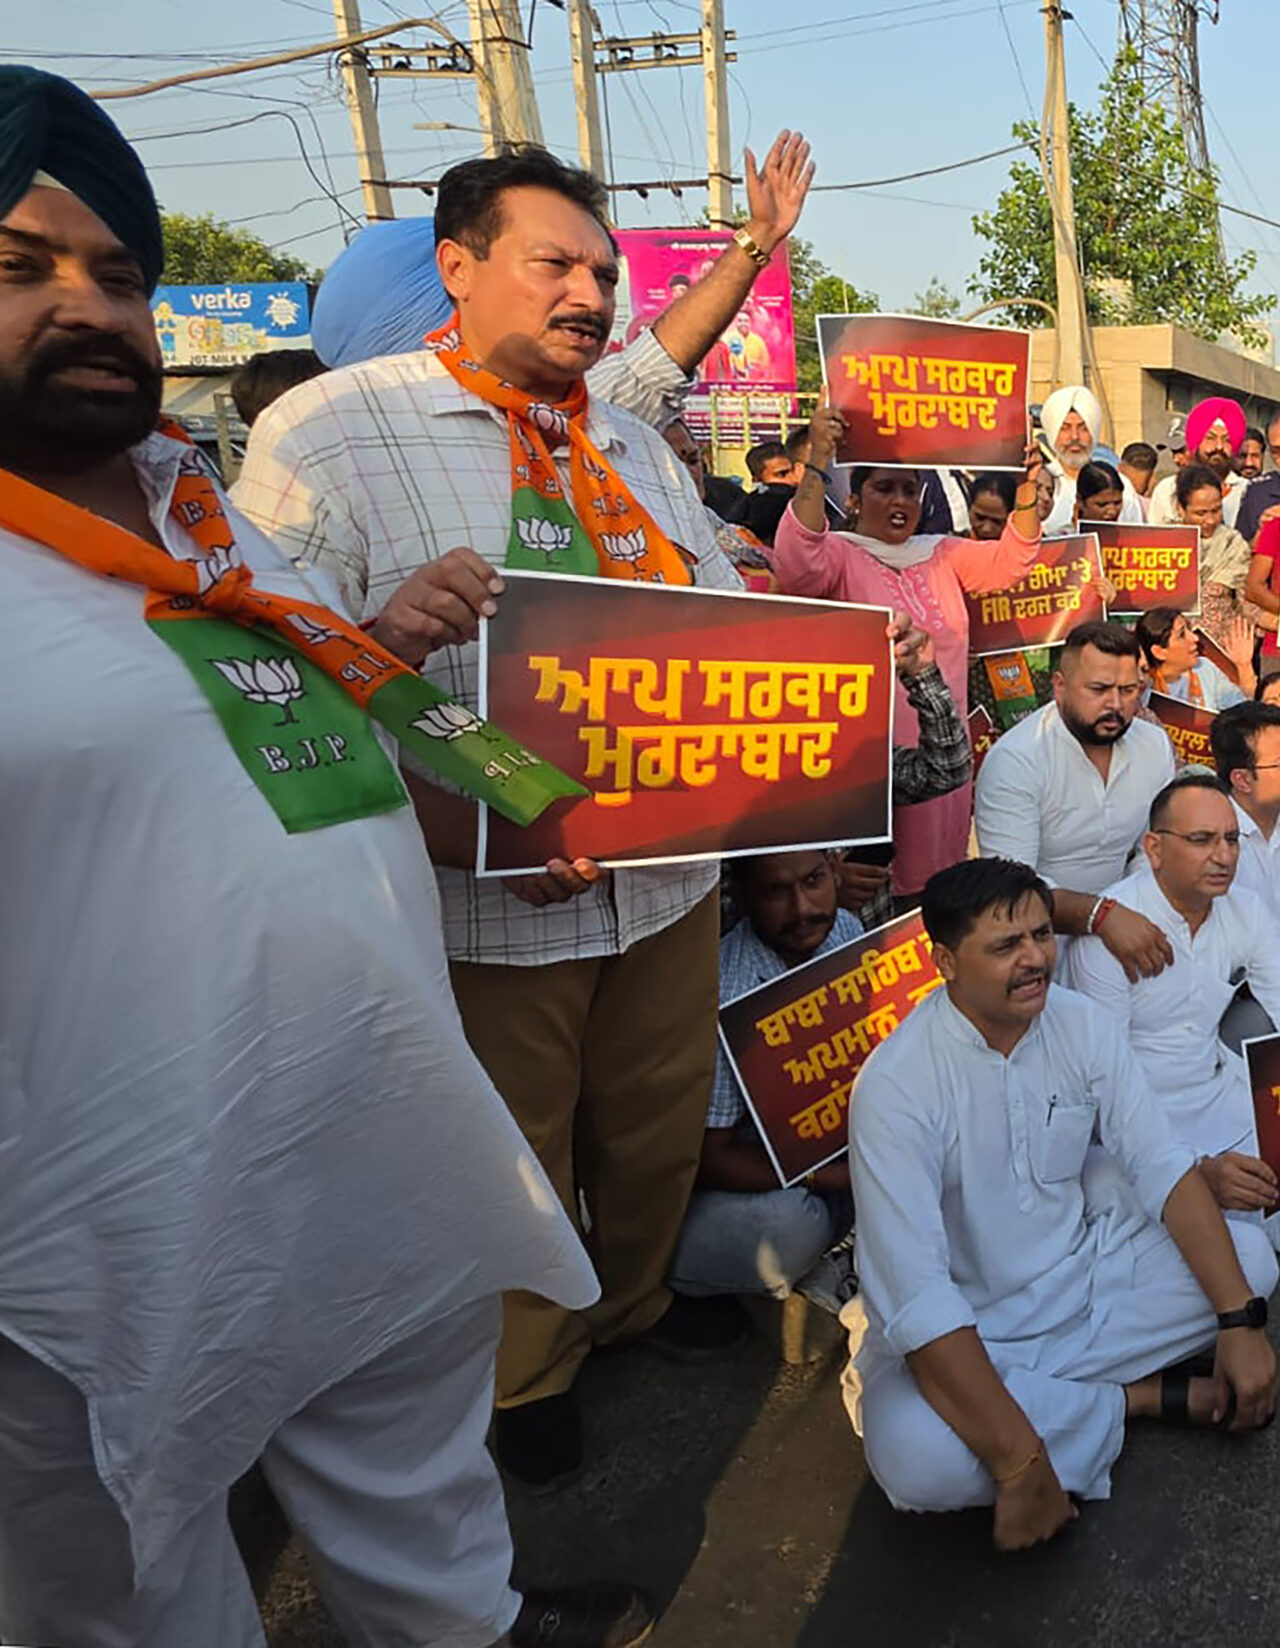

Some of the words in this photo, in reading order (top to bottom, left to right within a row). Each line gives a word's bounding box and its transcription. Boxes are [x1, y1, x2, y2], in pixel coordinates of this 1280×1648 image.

[191, 288, 252, 310] verka
[841, 354, 919, 391] ਆਪ
[922, 357, 1018, 396] ਸਰਕਾਰ
[868, 392, 998, 435] ਮੁਰਦਾਬਾਦ
[1029, 563, 1068, 590] ਚੀਮਾ
[1131, 547, 1192, 569] ਸਰਕਾਰ
[1106, 569, 1179, 590] ਰਦਾਬਾਦ
[981, 598, 1011, 624] FIR
[1013, 595, 1050, 619] ਦਰਜ
[1054, 584, 1082, 611] ਕਰੋ
[528, 656, 692, 721] ਆਪ
[698, 660, 875, 719] ਸਰਕਾਰ
[258, 733, 356, 776] B.J.P.
[578, 722, 839, 807] ਮੁਰਦਾਬਾਦ
[756, 986, 829, 1047] ਬਾਬਾ
[830, 940, 923, 1006] ਸਾਹਿਬ
